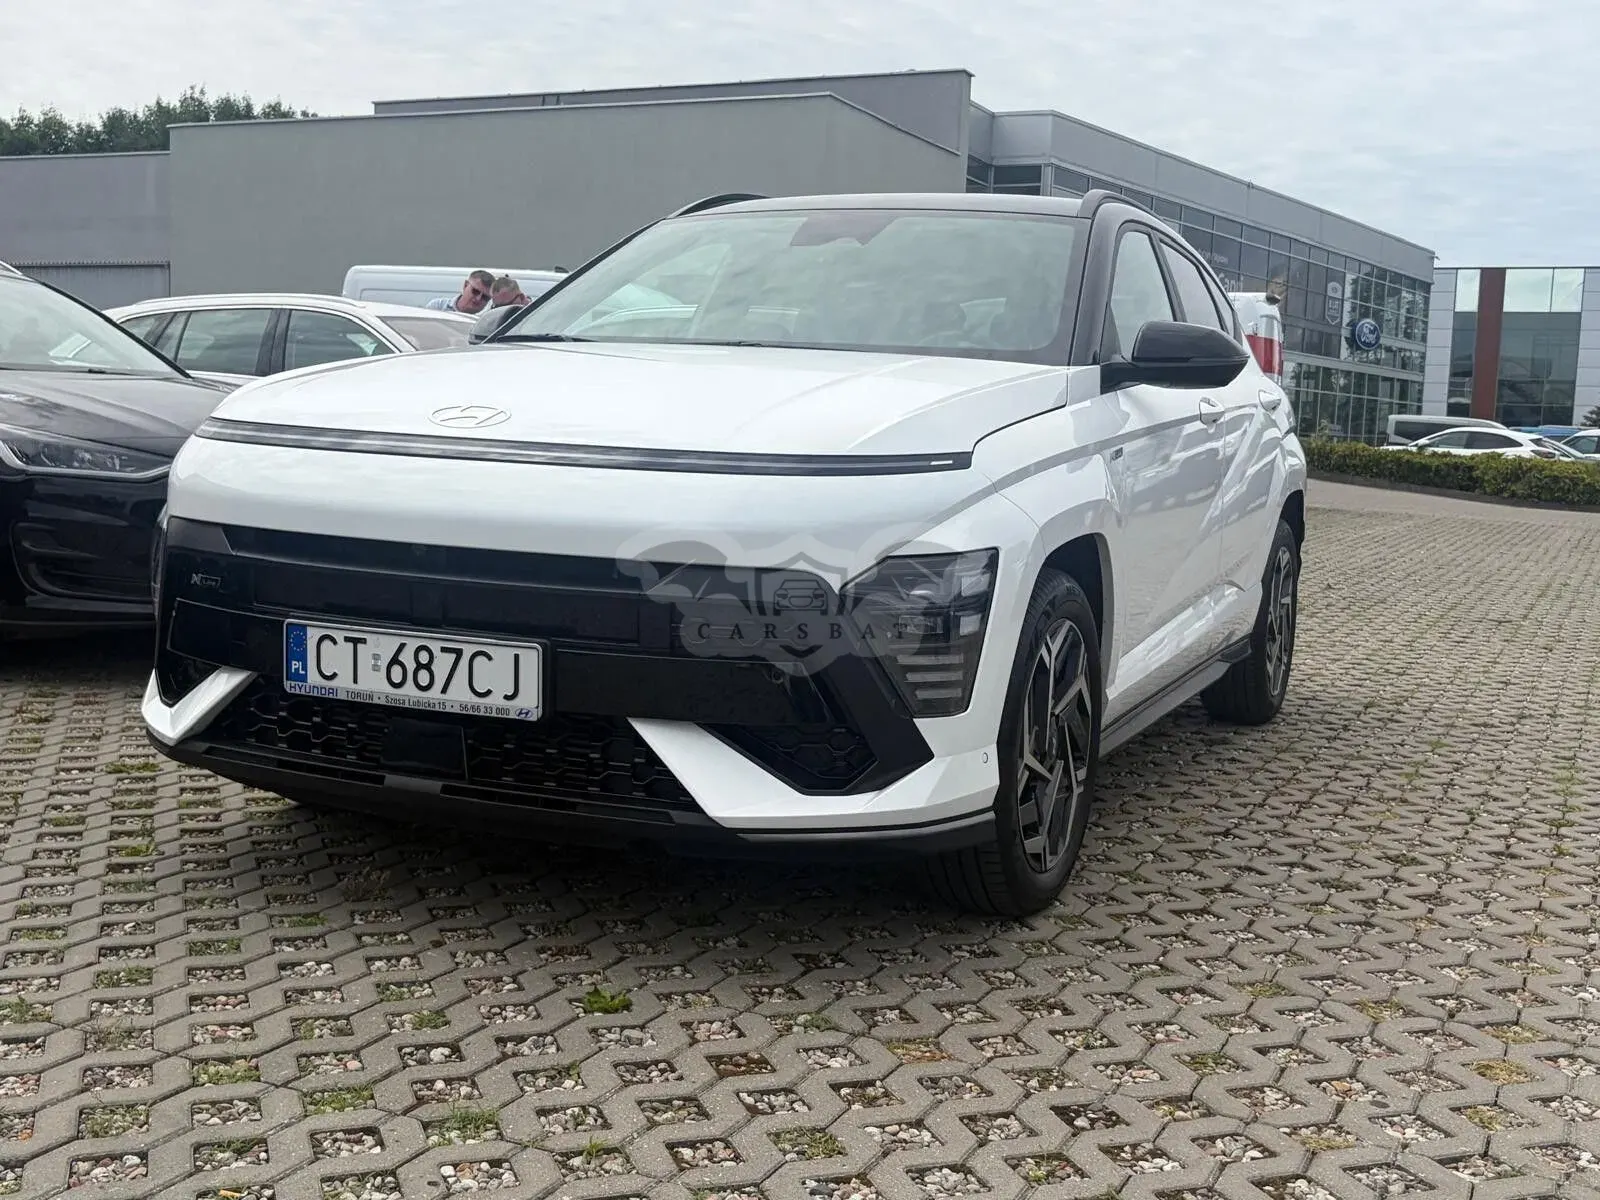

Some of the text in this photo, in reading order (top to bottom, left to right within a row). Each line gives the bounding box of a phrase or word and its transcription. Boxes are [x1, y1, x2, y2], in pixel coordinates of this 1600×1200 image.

[291, 660, 306, 675] PL
[316, 634, 520, 701] CT 687CJ
[289, 682, 338, 697] HYUNDAI
[438, 702, 447, 710] 15
[459, 704, 482, 713] 56/66
[484, 706, 493, 715] 33
[496, 707, 510, 716] 000
